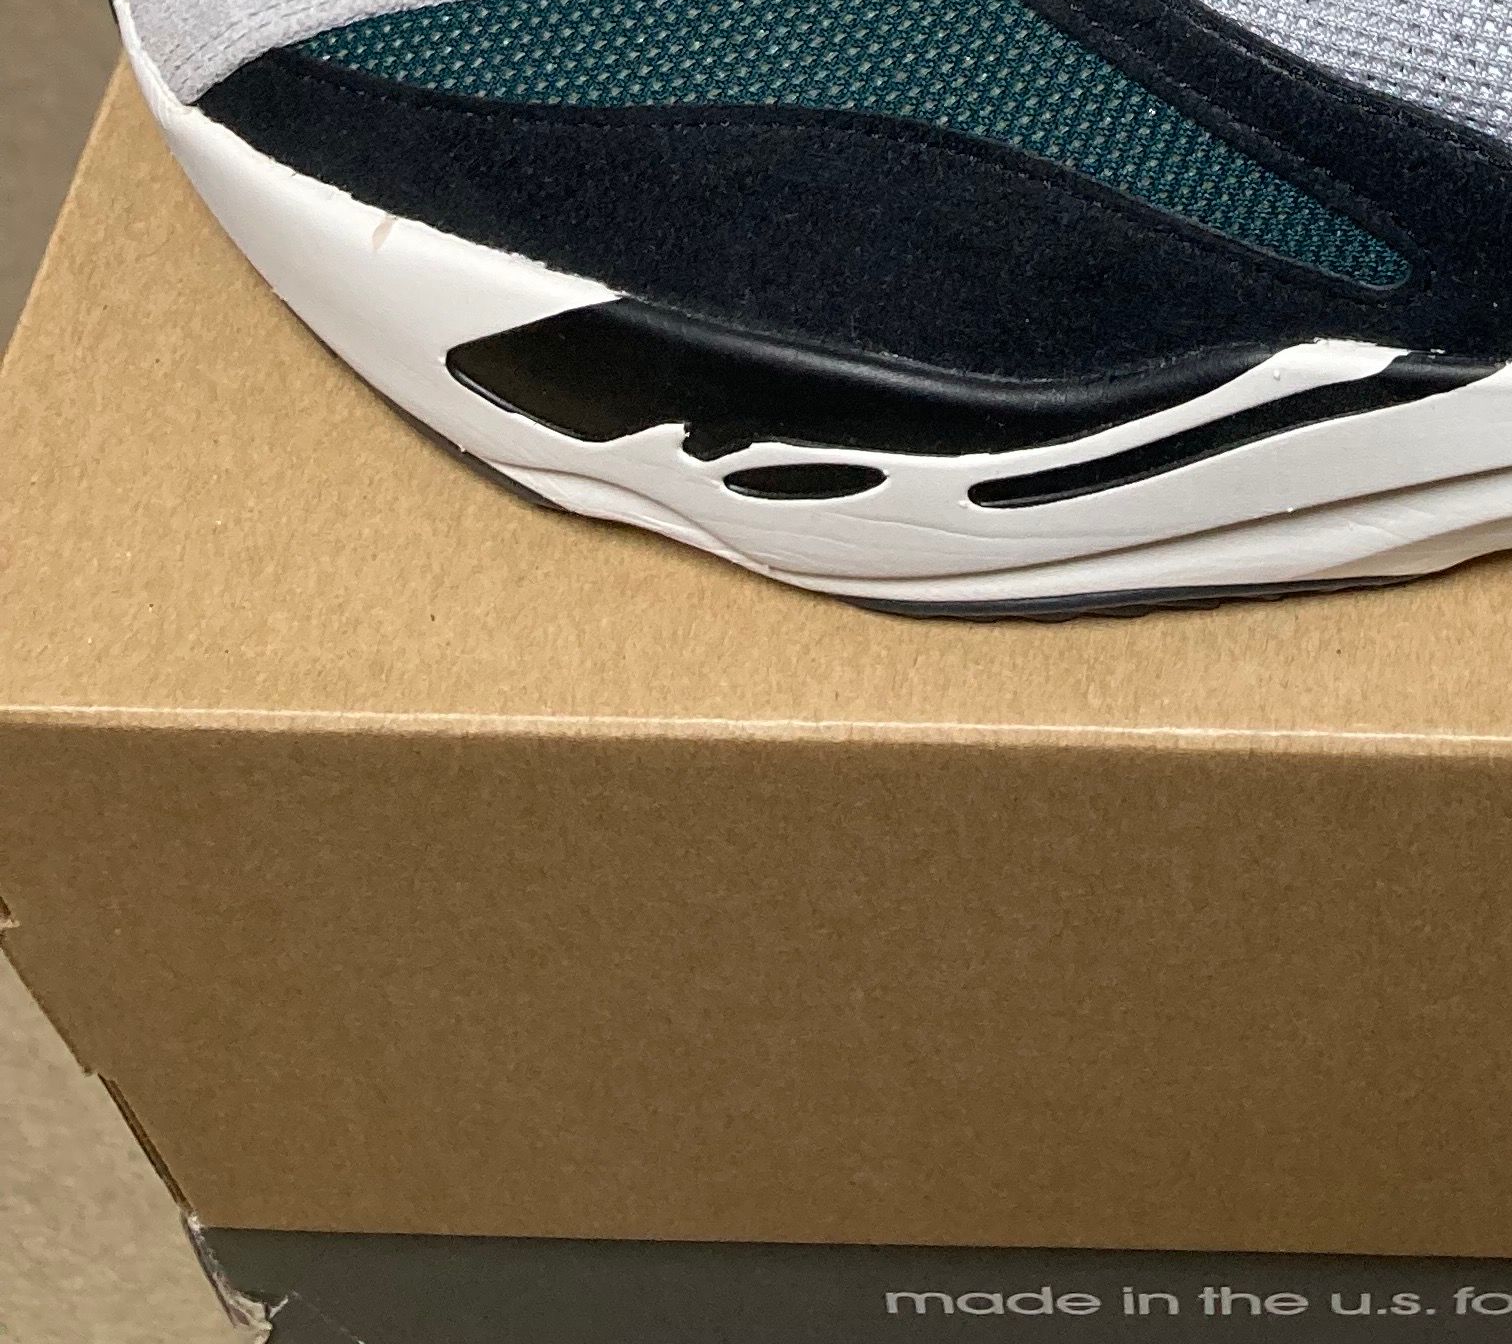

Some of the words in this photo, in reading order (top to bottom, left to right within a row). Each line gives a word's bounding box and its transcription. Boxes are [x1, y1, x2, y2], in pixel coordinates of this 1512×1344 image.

[885, 1286, 1102, 1315] made
[1122, 1286, 1181, 1315] in
[1197, 1286, 1309, 1316] the
[1331, 1292, 1436, 1316] u.s.
